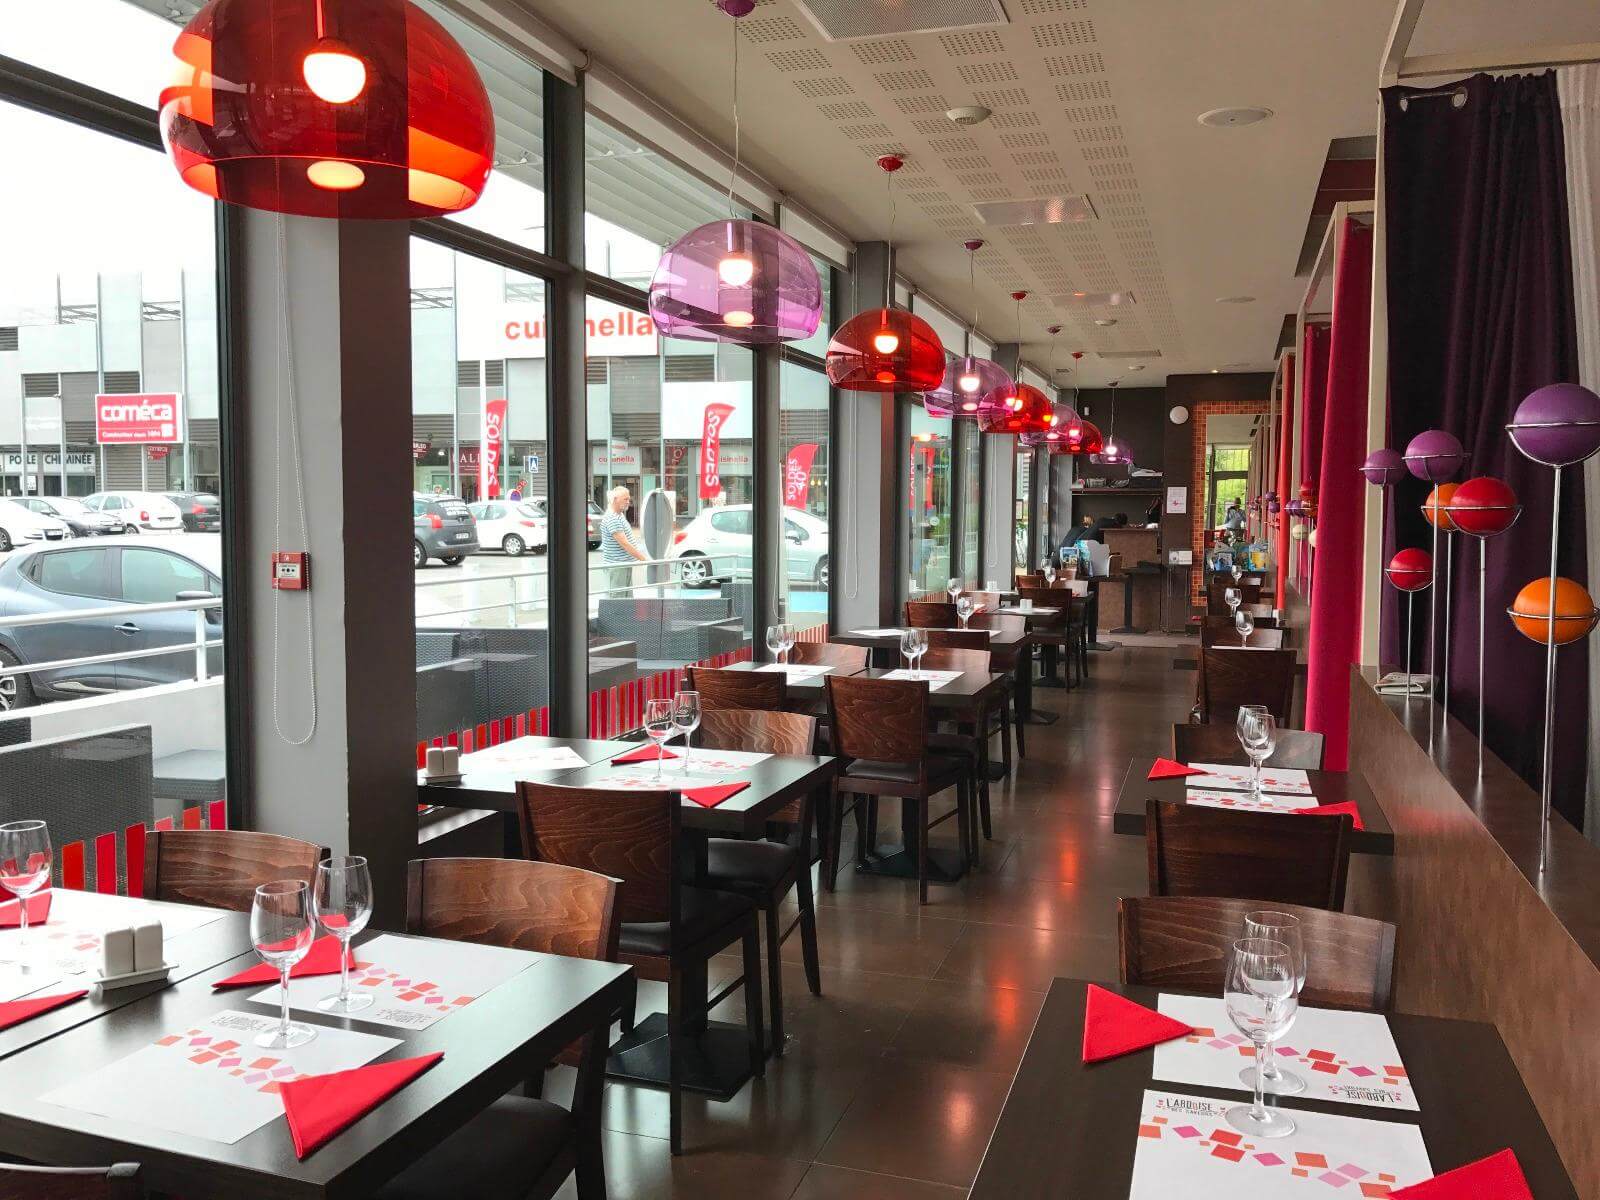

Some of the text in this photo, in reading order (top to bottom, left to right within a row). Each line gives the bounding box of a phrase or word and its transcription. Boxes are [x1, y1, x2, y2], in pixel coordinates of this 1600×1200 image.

[505, 311, 654, 341] cunella
[101, 399, 173, 421] coméca
[9, 455, 36, 464] POLE
[705, 411, 721, 487] SOLDES
[788, 458, 798, 500] SOLDES
